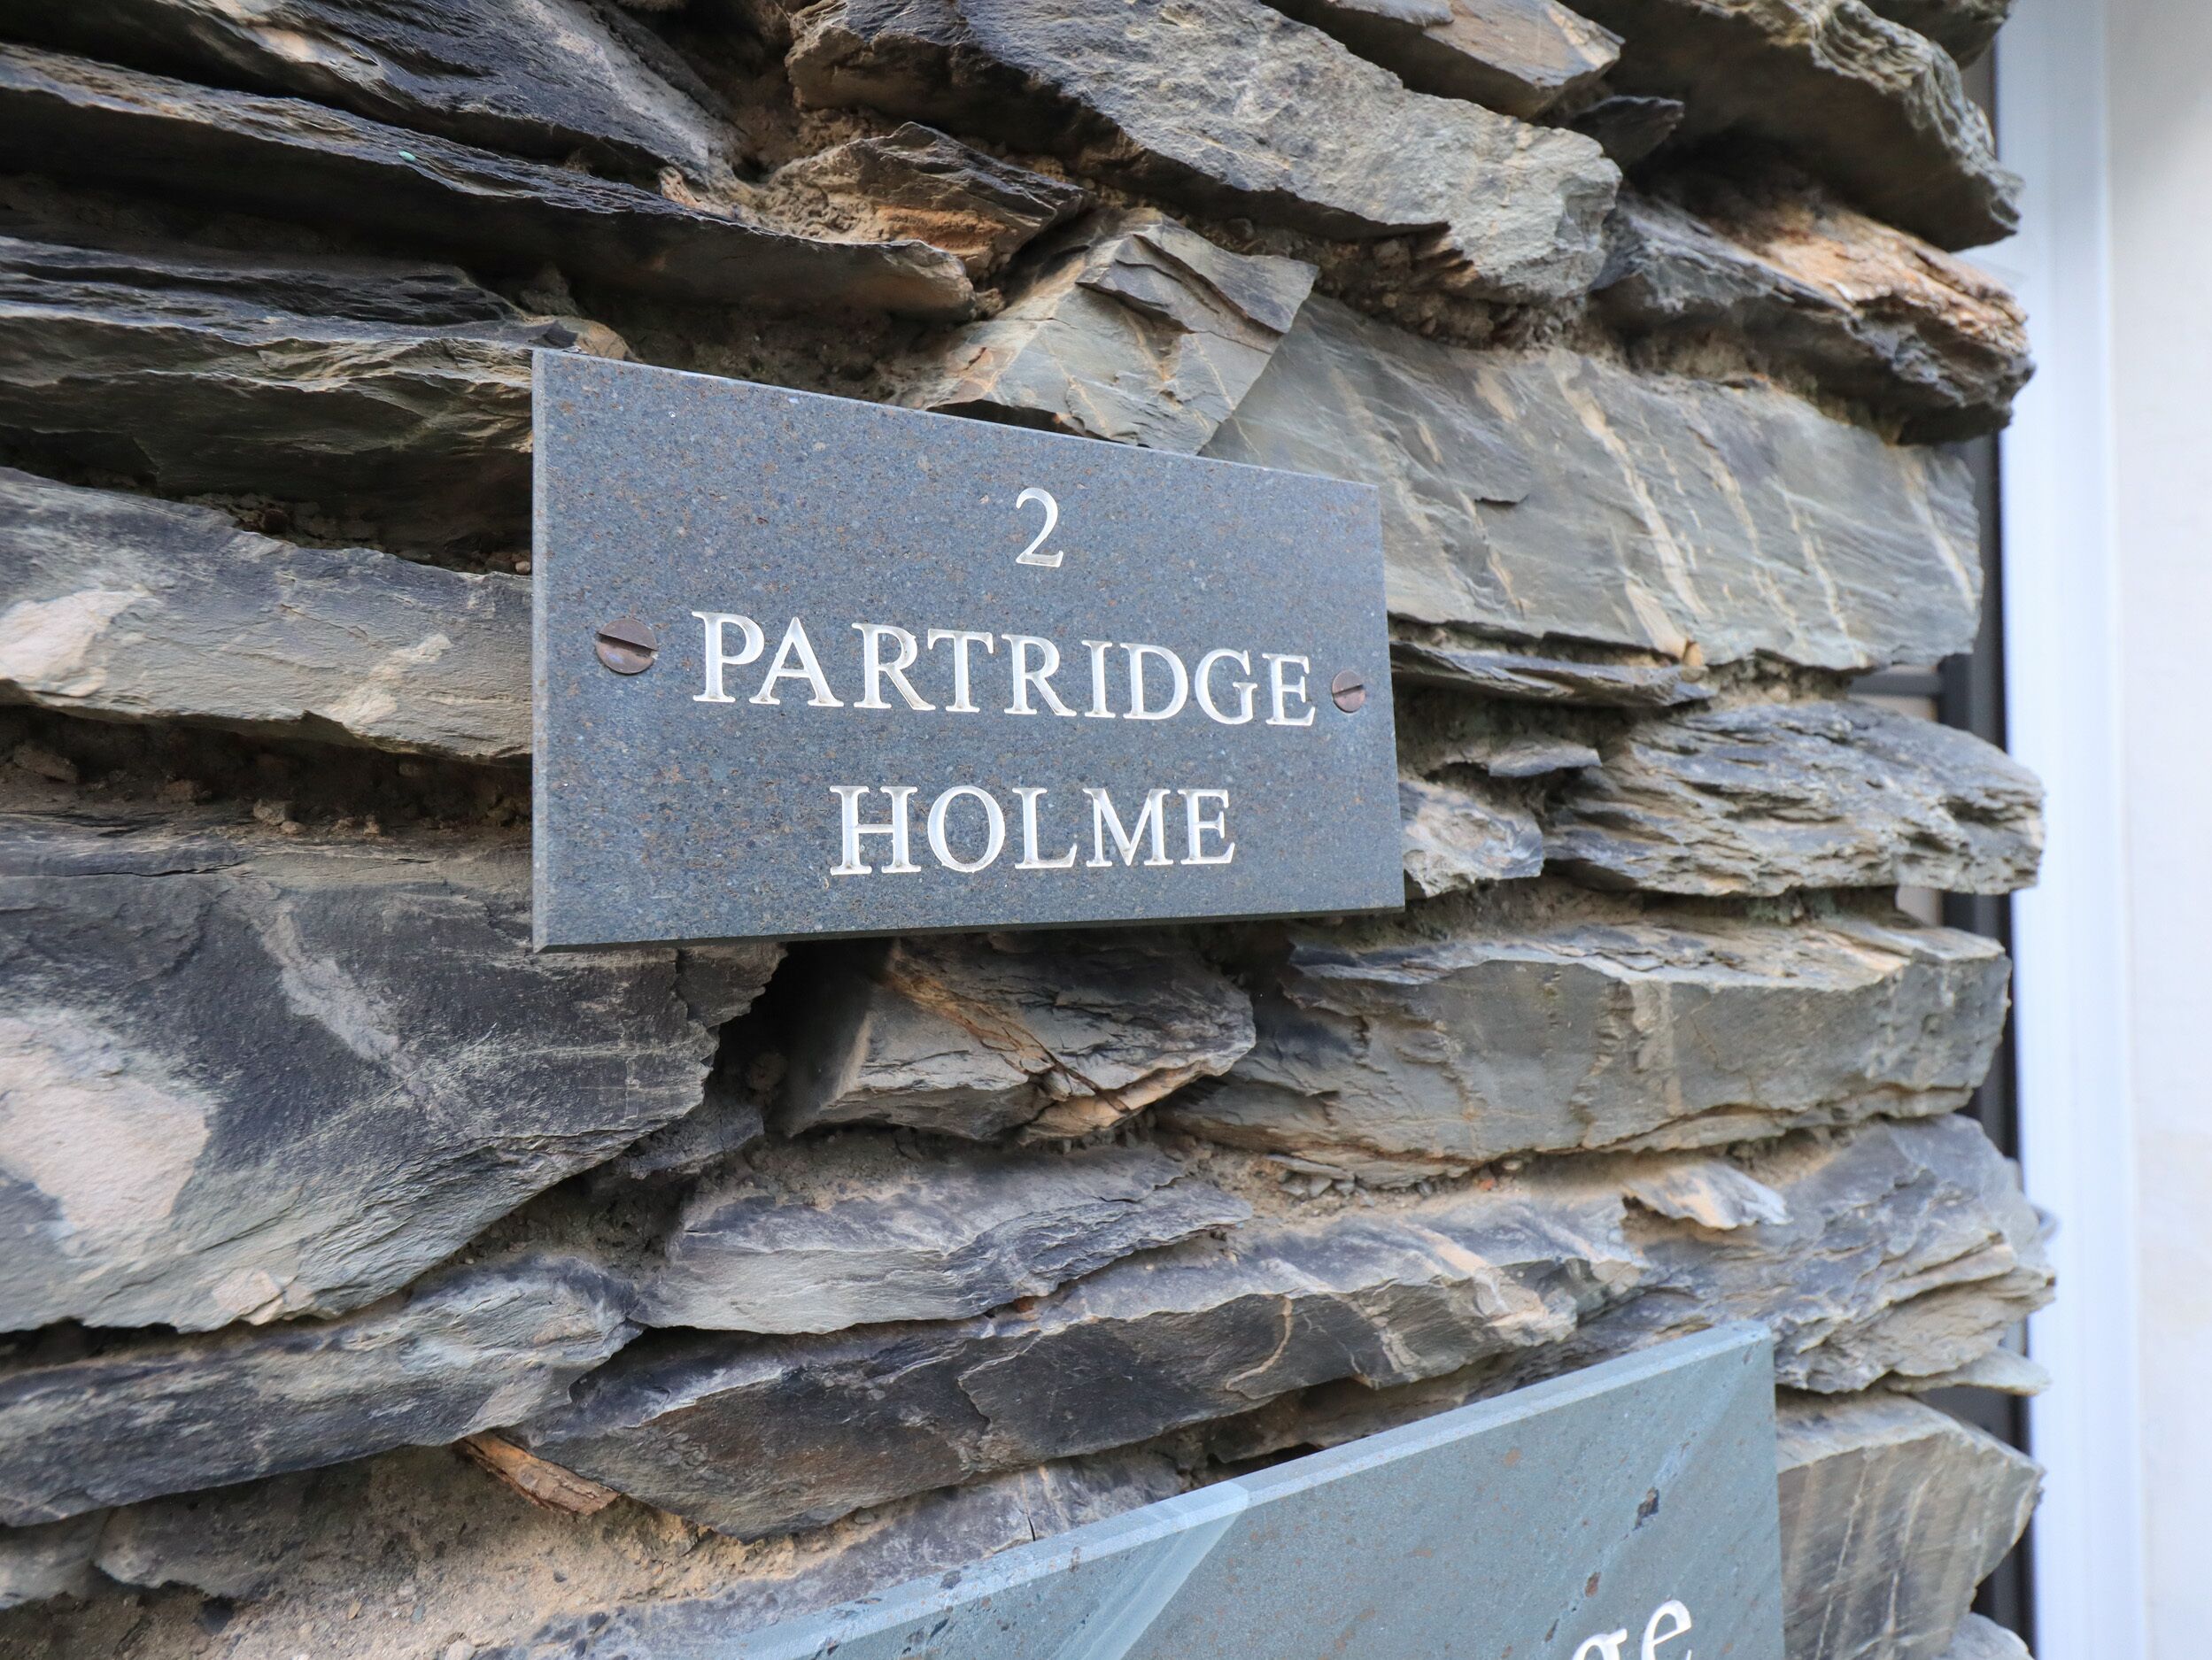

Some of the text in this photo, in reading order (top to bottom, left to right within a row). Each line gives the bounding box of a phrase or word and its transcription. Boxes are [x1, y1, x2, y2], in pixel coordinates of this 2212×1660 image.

[1015, 487, 1064, 568] 2
[691, 611, 1317, 727] PARTRIDGE
[829, 784, 1237, 876] HOLME
